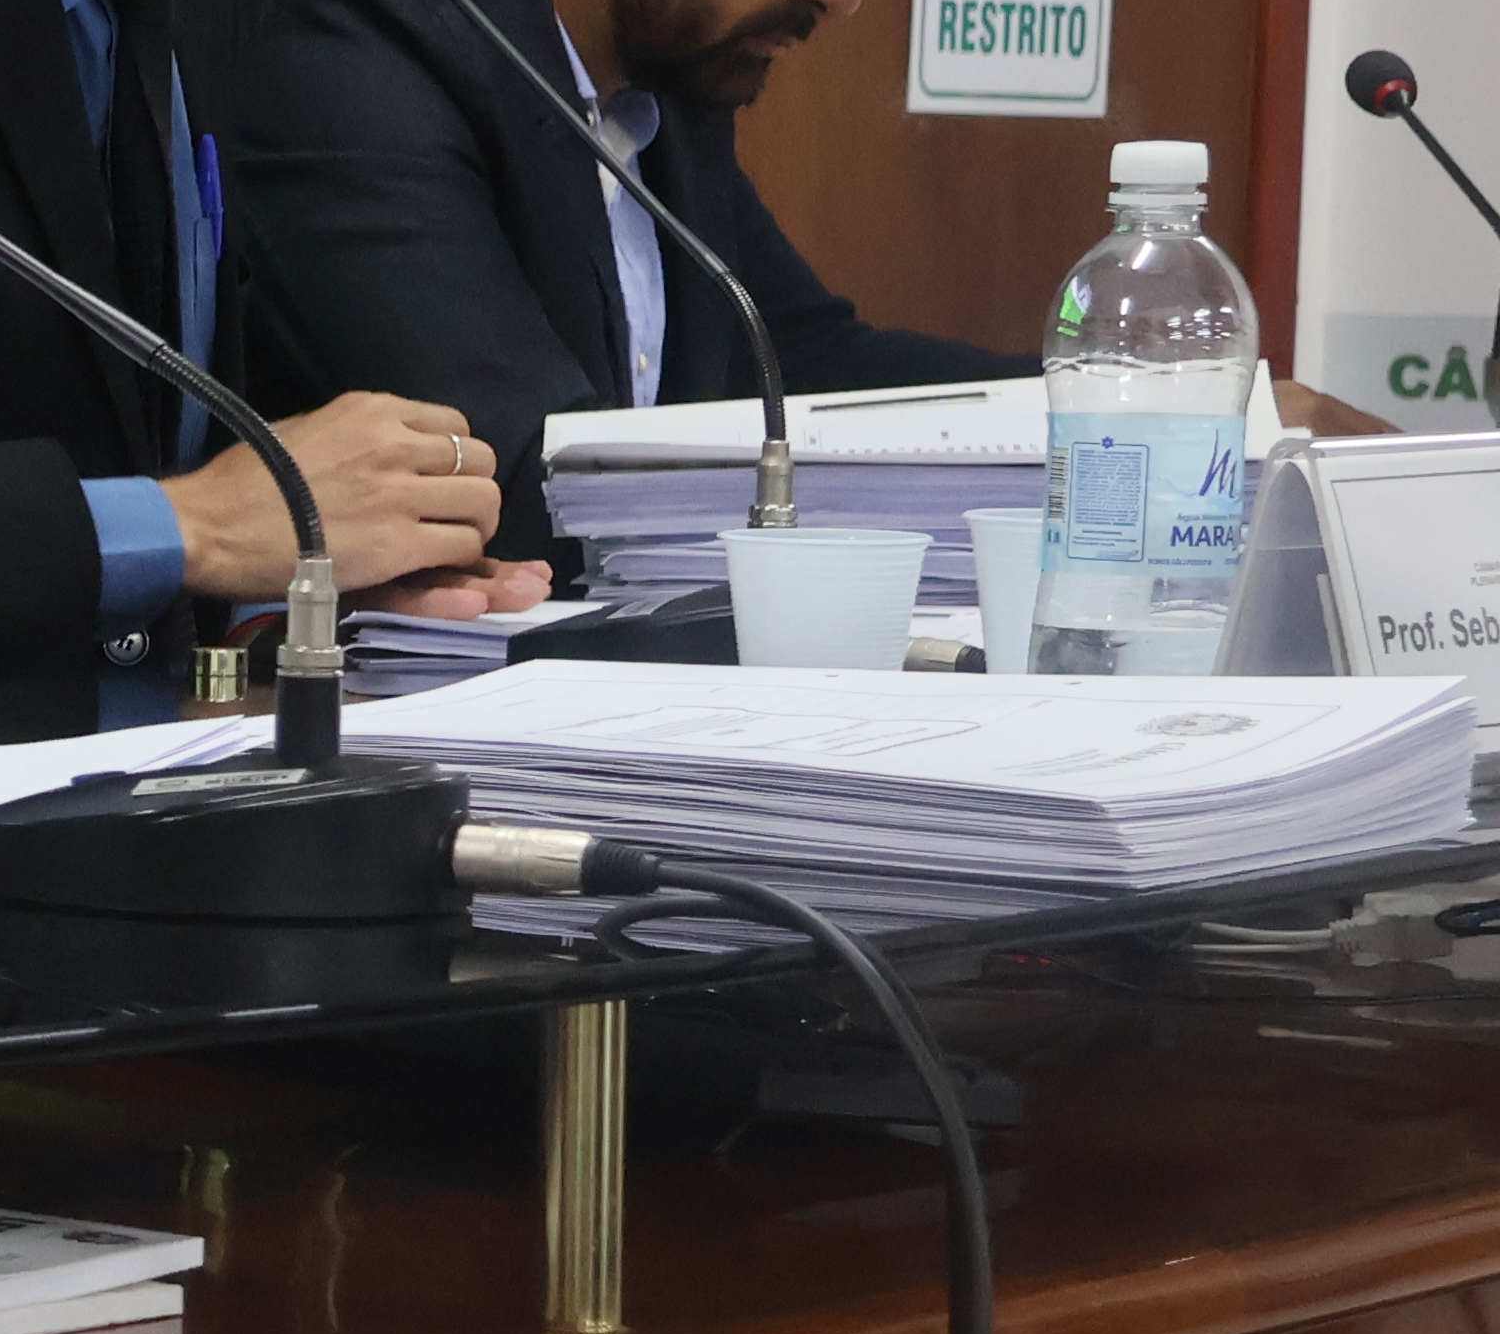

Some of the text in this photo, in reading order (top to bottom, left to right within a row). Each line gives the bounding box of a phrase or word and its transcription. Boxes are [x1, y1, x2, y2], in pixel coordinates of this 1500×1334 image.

[938, 0, 1087, 57] RESTRITO
[1378, 606, 1500, 655] Prof. Seb
